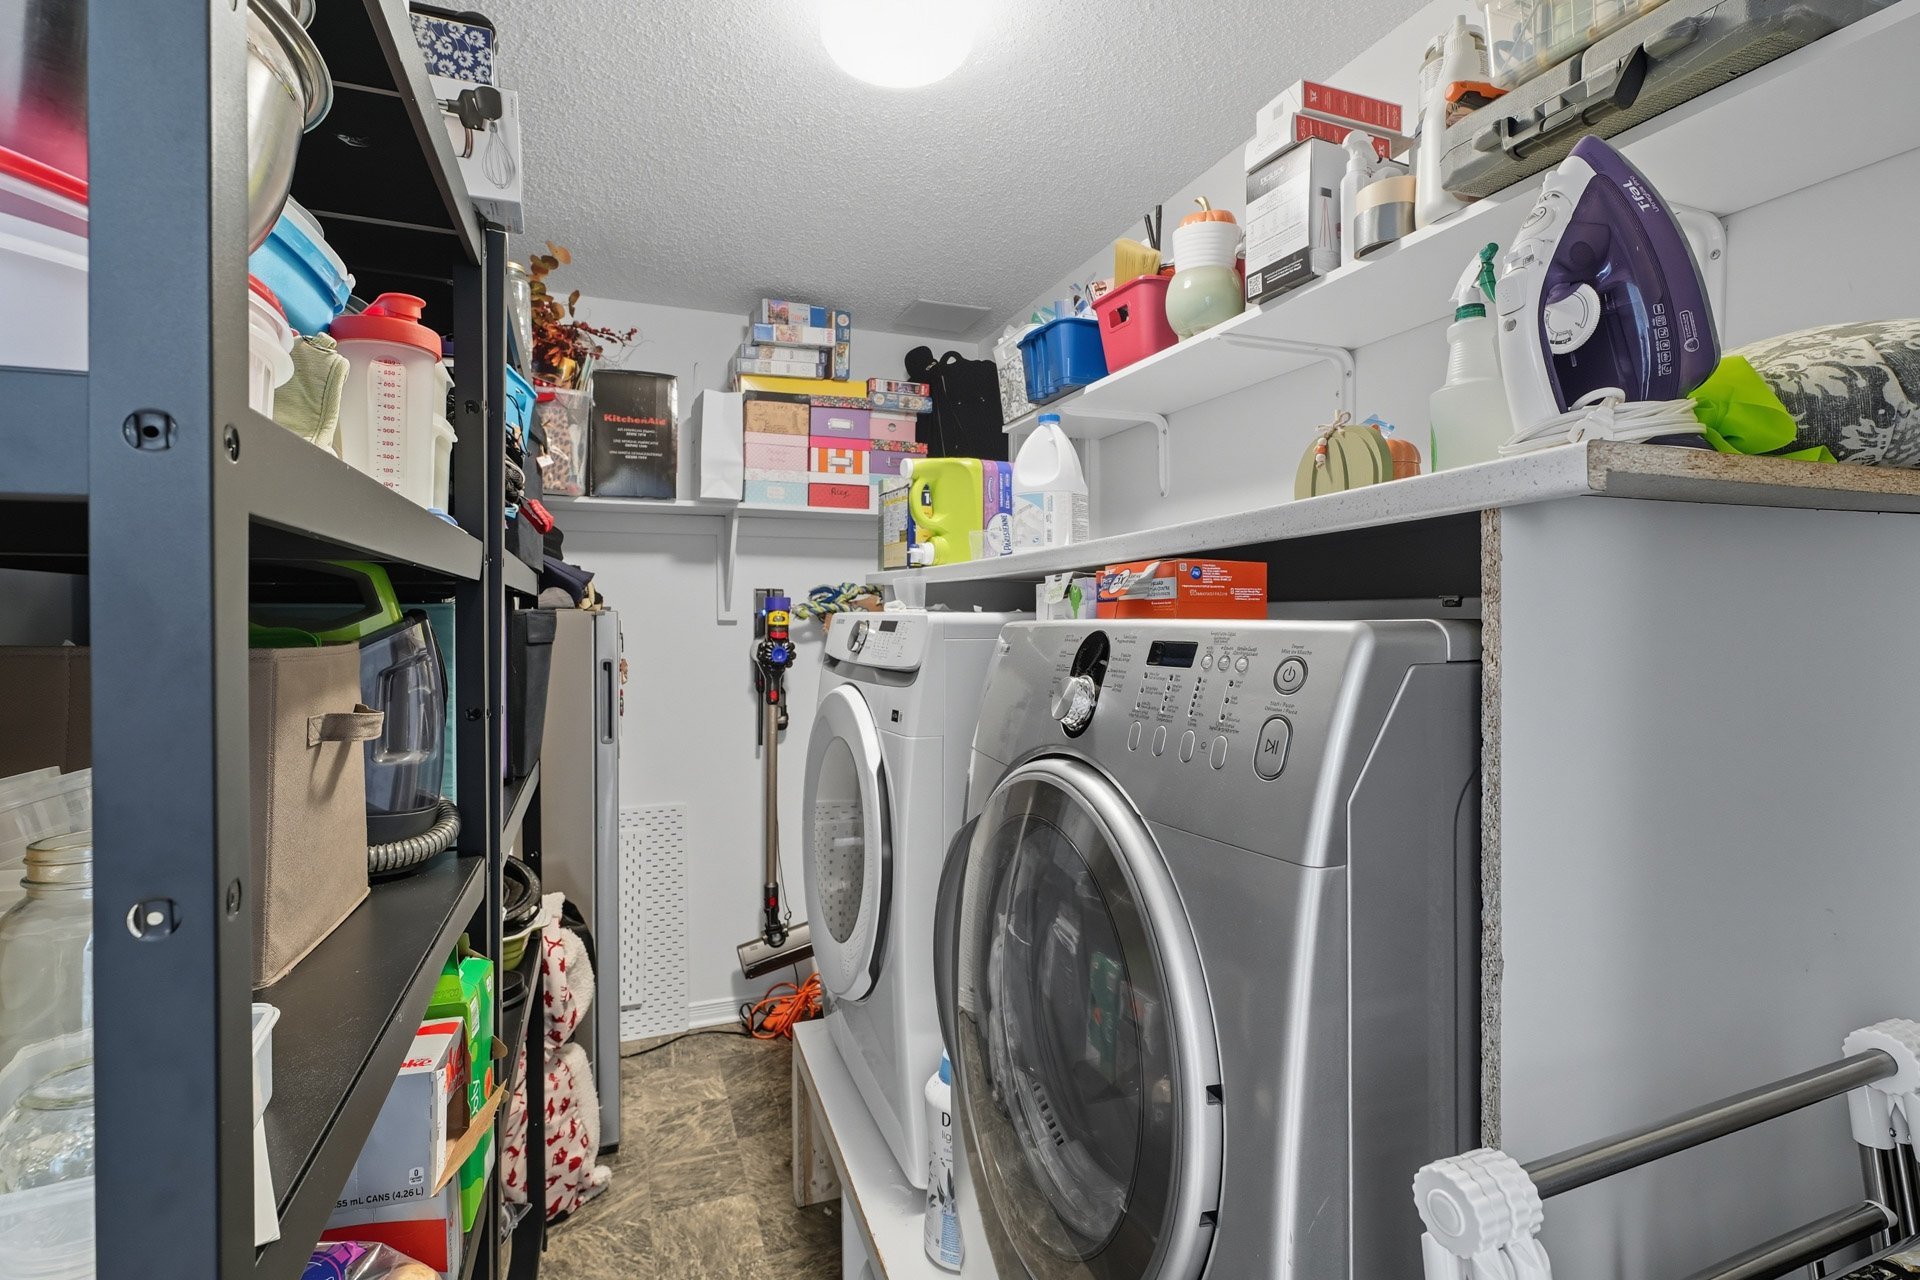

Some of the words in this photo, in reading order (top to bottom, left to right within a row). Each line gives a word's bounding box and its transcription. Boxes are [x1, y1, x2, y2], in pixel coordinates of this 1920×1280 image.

[603, 413, 667, 426] KitchenAid
[941, 1111, 951, 1127] D
[941, 1129, 952, 1144] lig
[413, 1168, 419, 1177] 0
[335, 1199, 348, 1209] 55
[350, 1197, 364, 1206] mL
[365, 1193, 390, 1204] CANS
[392, 1188, 414, 1201] (4.26
[415, 1186, 424, 1196] L)
